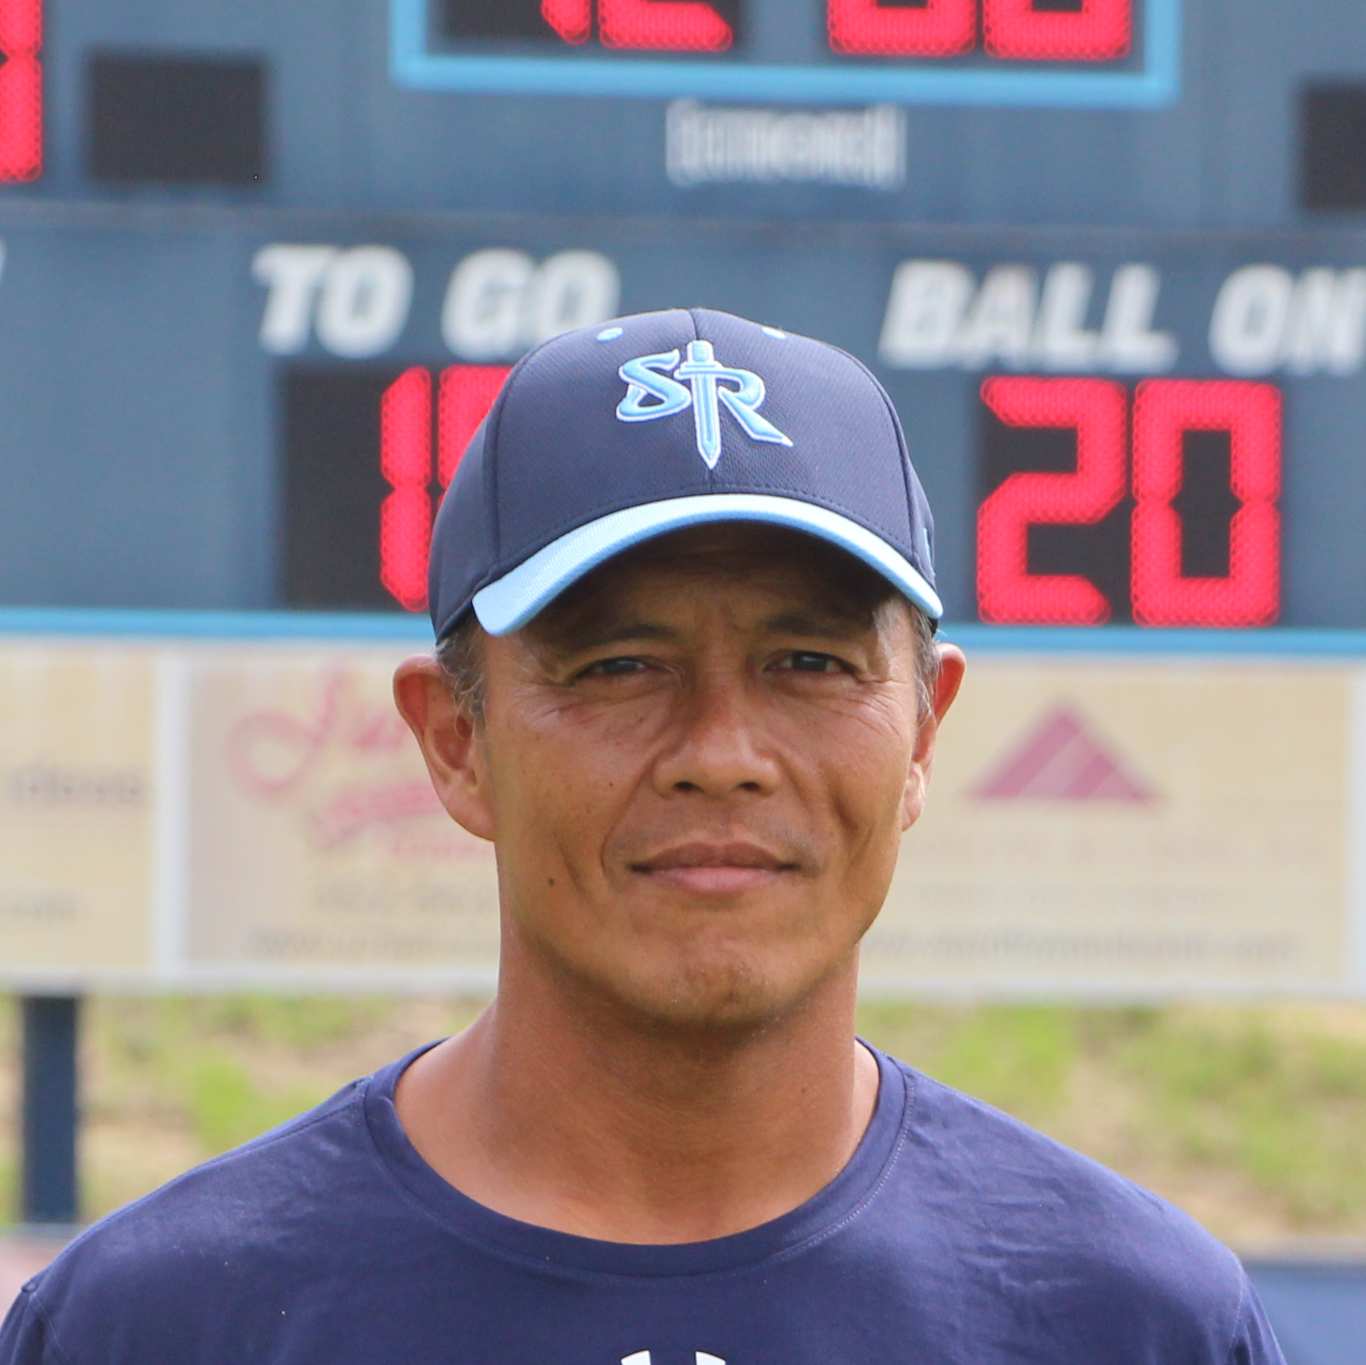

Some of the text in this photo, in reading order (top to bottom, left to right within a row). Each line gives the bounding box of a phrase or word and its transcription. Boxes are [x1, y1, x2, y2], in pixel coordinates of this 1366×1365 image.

[251, 243, 623, 359] TO GO
[879, 259, 1178, 373] BALL
[976, 375, 1284, 627] 20
